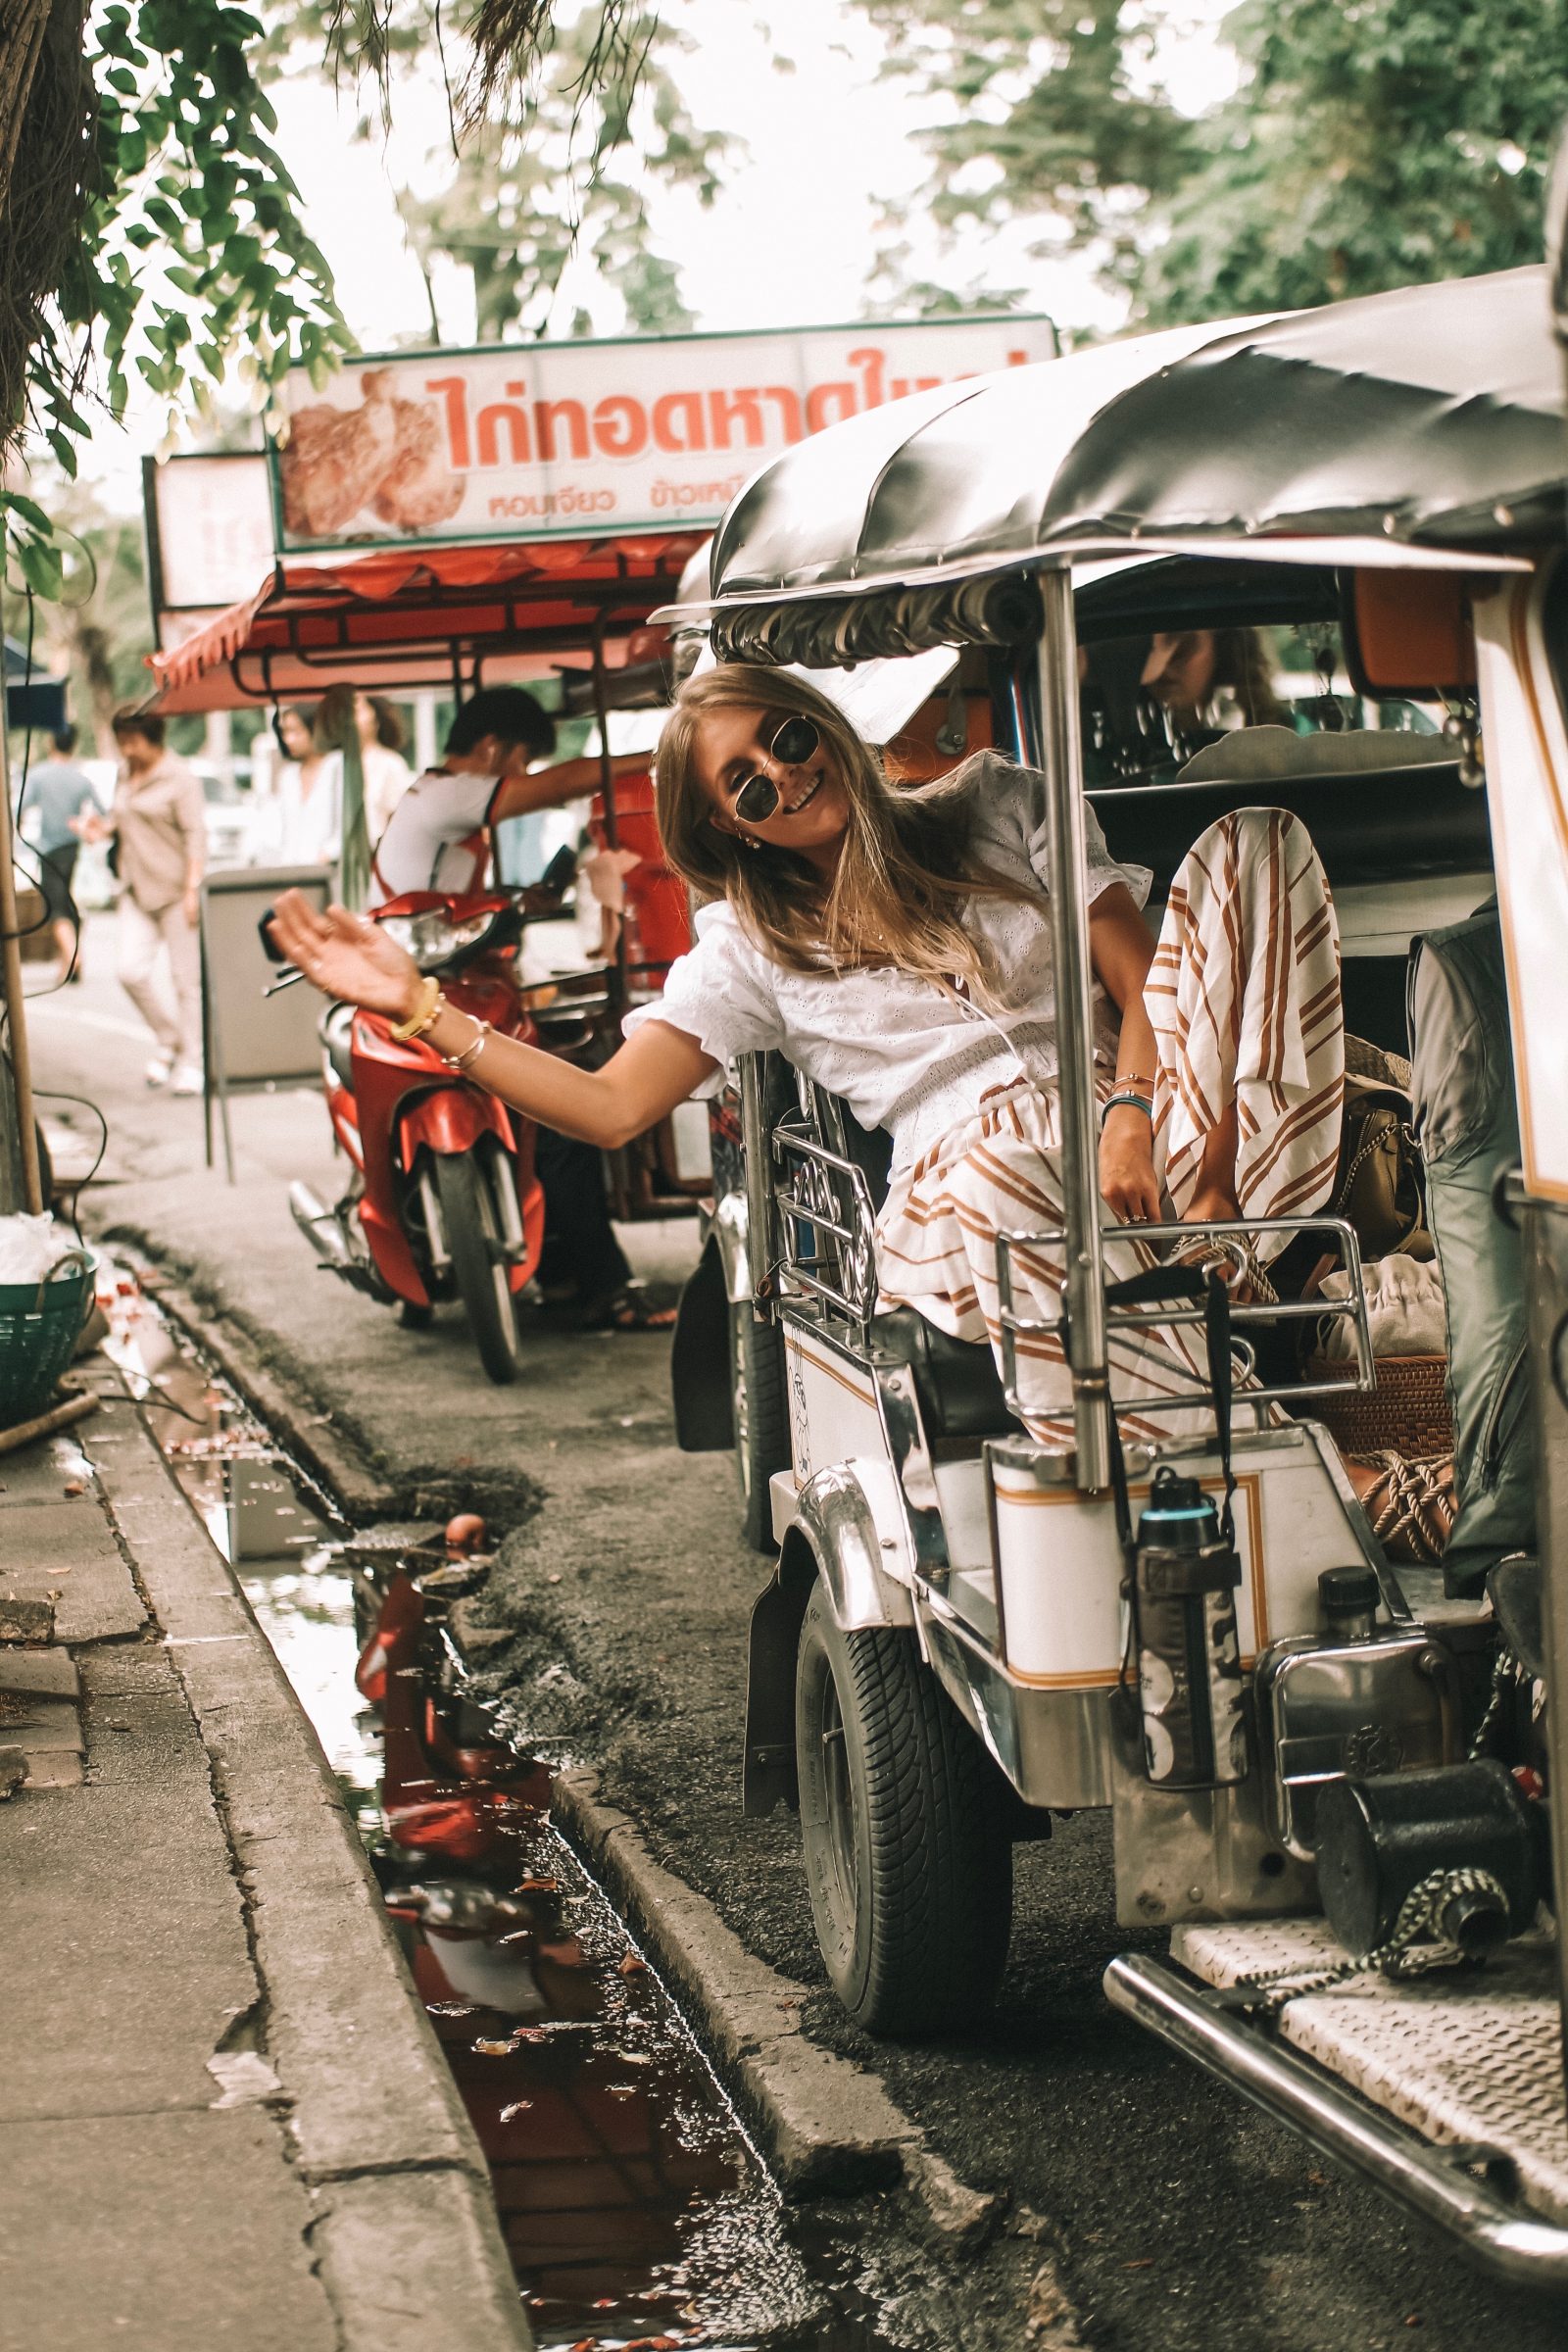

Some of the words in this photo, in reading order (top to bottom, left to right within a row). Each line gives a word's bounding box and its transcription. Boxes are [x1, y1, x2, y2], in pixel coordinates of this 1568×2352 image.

[424, 347, 1029, 469] ไก่ทอดหาดใ่
